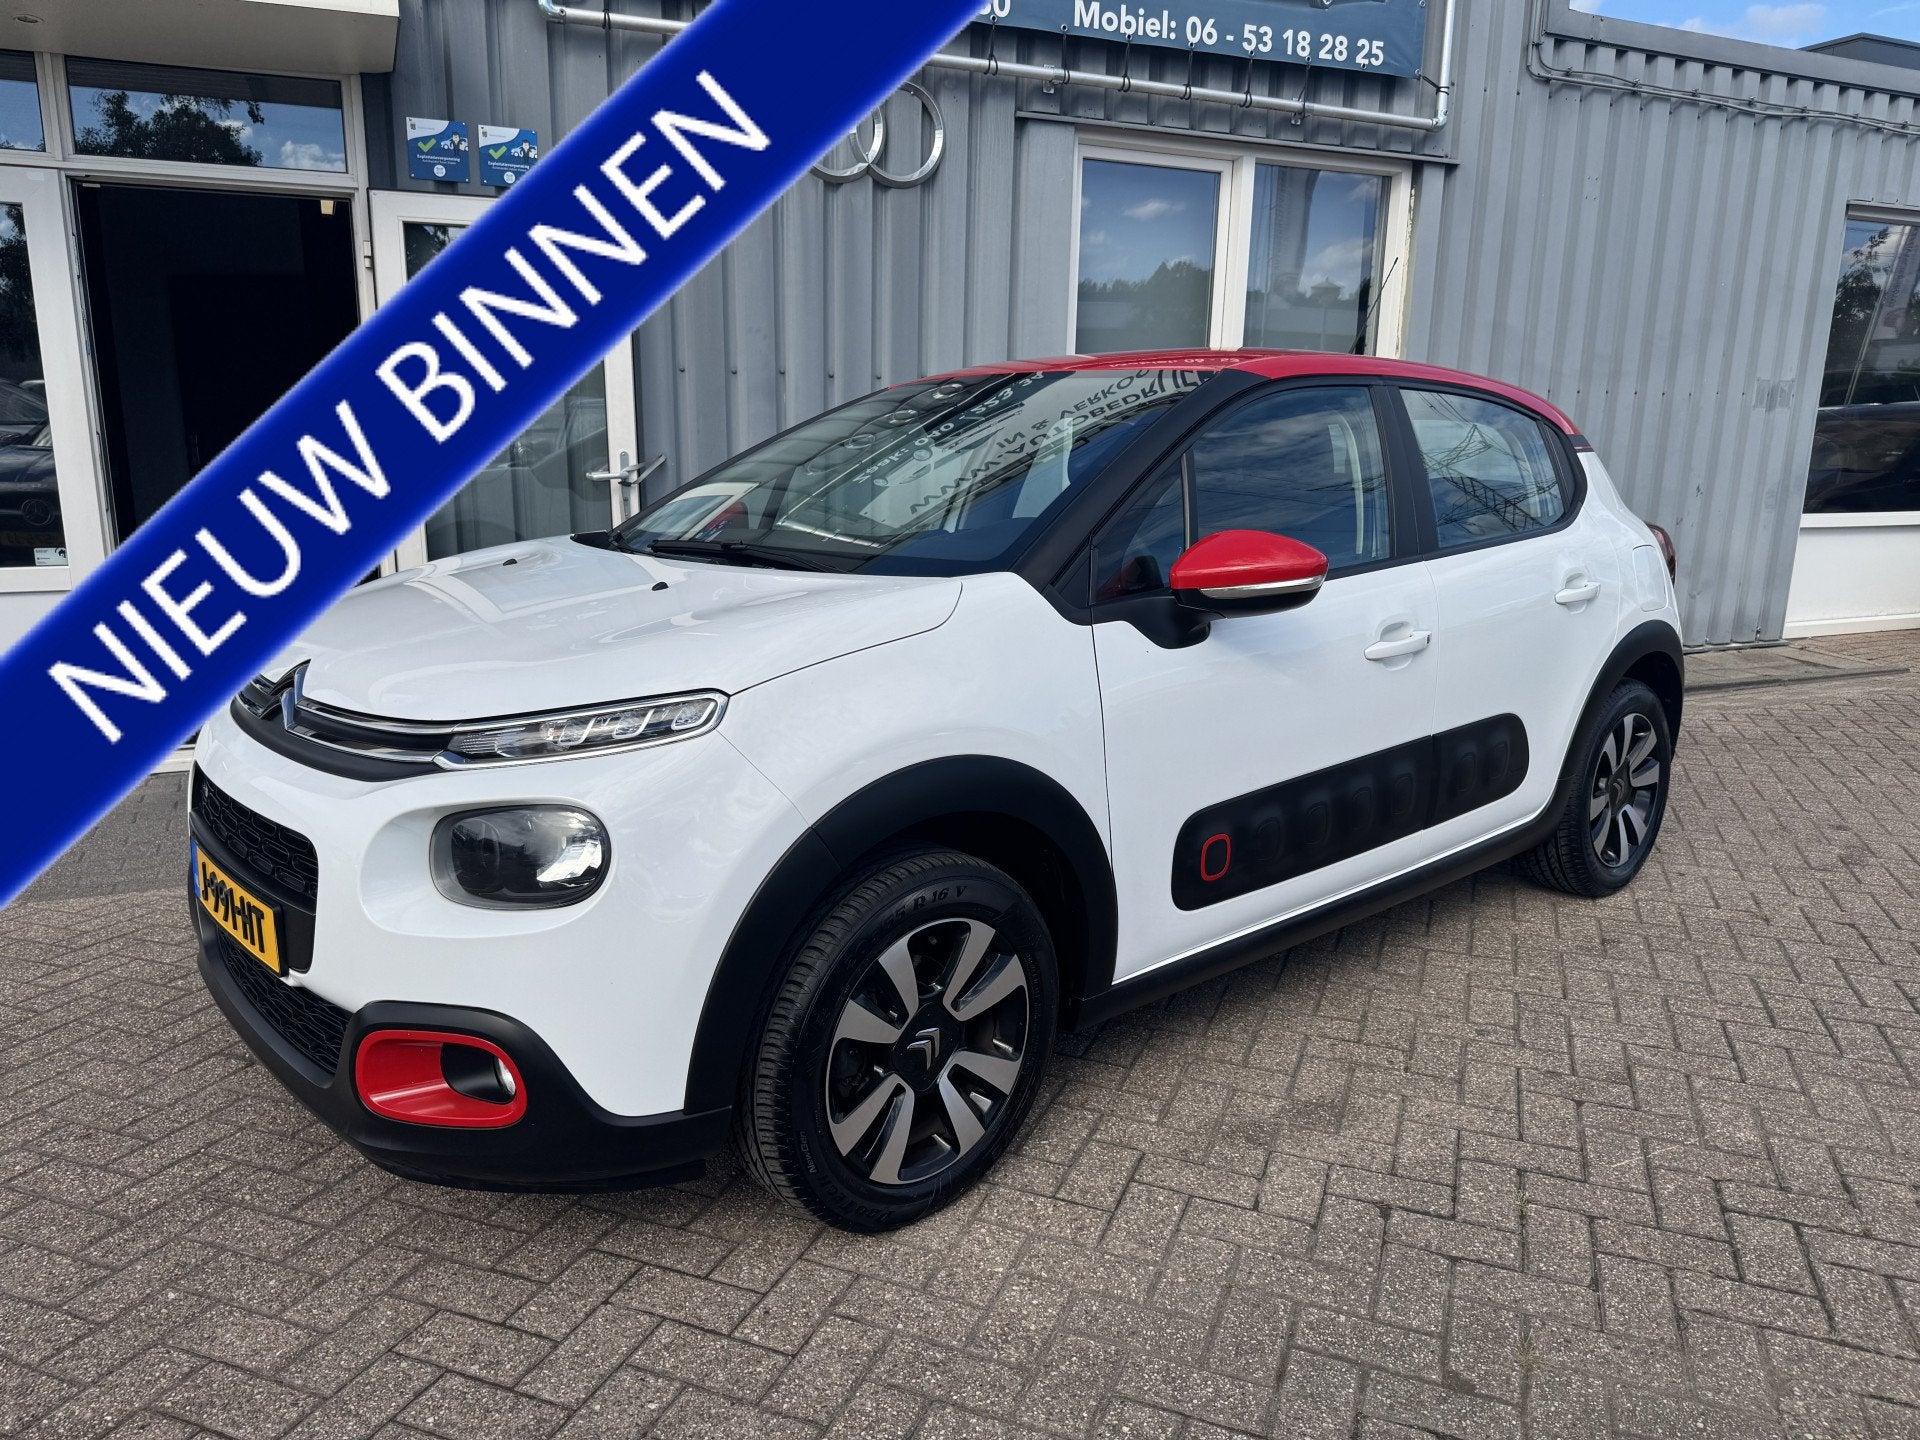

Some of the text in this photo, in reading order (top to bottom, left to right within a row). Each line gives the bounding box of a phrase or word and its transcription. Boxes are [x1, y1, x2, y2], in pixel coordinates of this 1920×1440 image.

[1074, 1, 1177, 40] Mobiel:
[1186, 15, 1218, 45] 06
[1226, 34, 1234, 42] -
[1242, 23, 1273, 52] 53
[1282, 29, 1311, 58] 18
[1318, 33, 1348, 61] 28
[1356, 38, 1385, 66] 25
